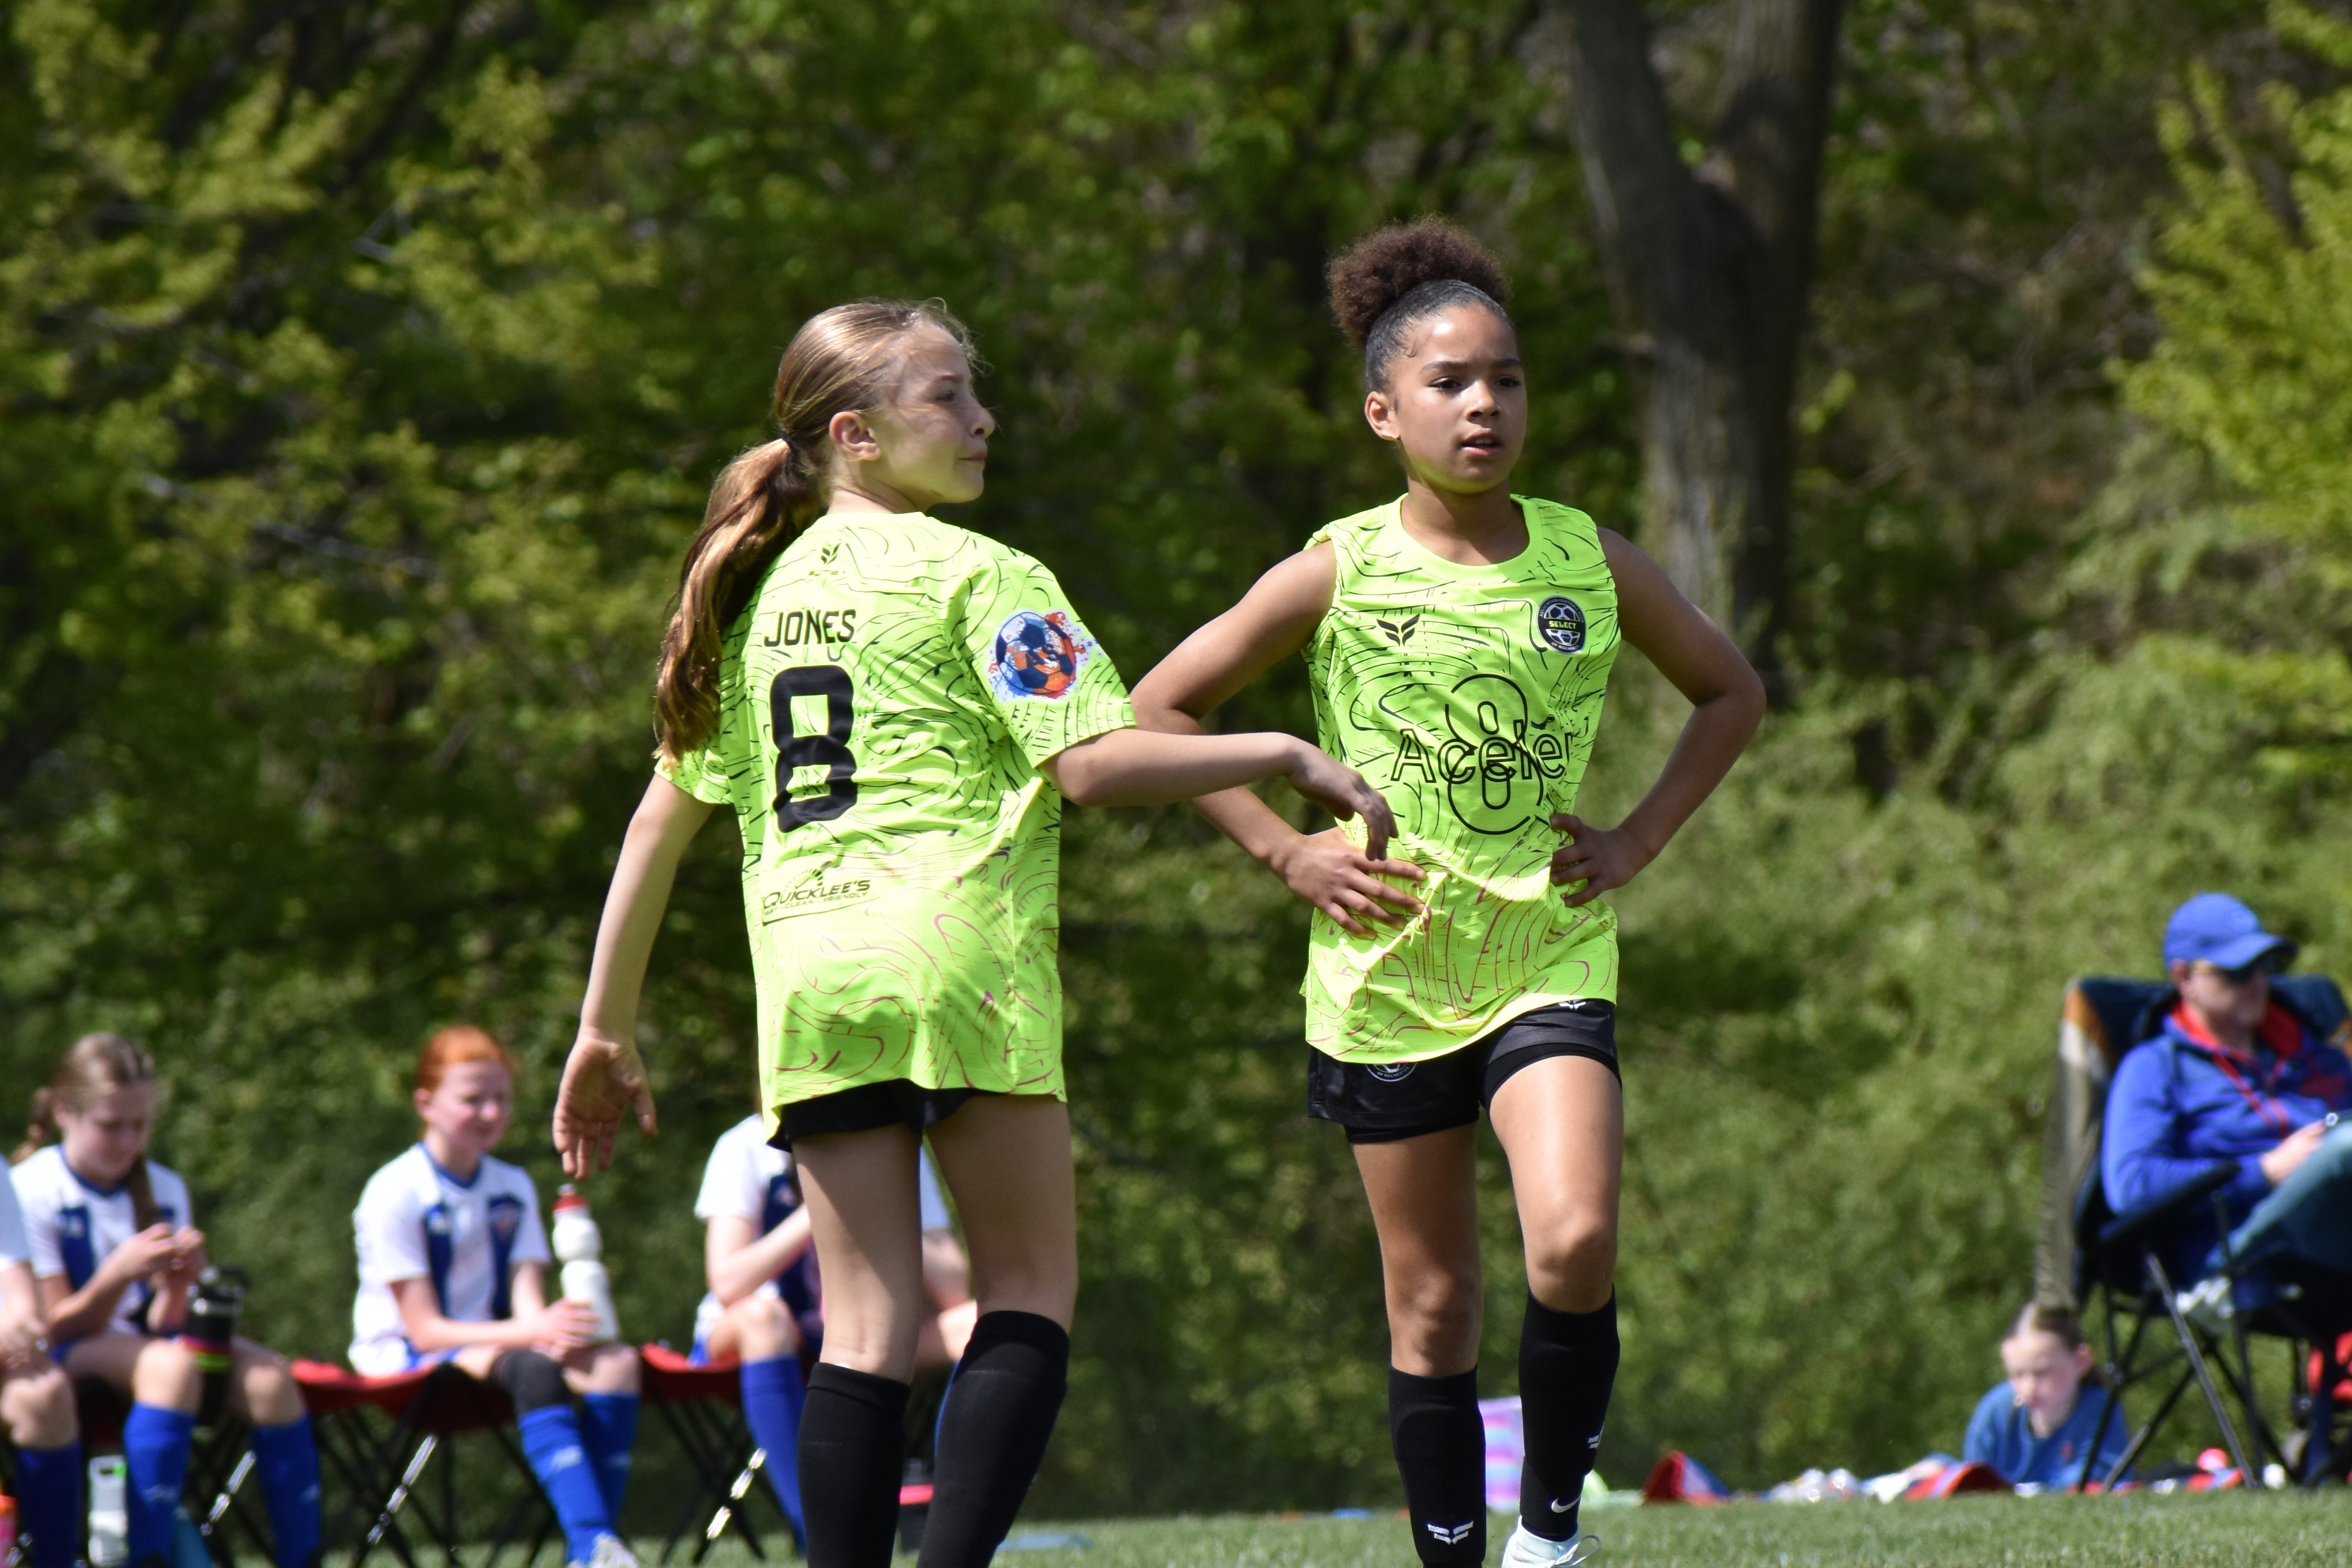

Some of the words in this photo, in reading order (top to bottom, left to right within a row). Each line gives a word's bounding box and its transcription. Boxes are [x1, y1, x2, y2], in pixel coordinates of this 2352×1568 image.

[763, 609, 856, 647] JONES
[1548, 620, 1577, 630] SELECT
[769, 664, 858, 834] 8
[1445, 673, 1545, 835] 8
[784, 900, 815, 909] CLEAN
[823, 891, 868, 902] FRIENDLY
